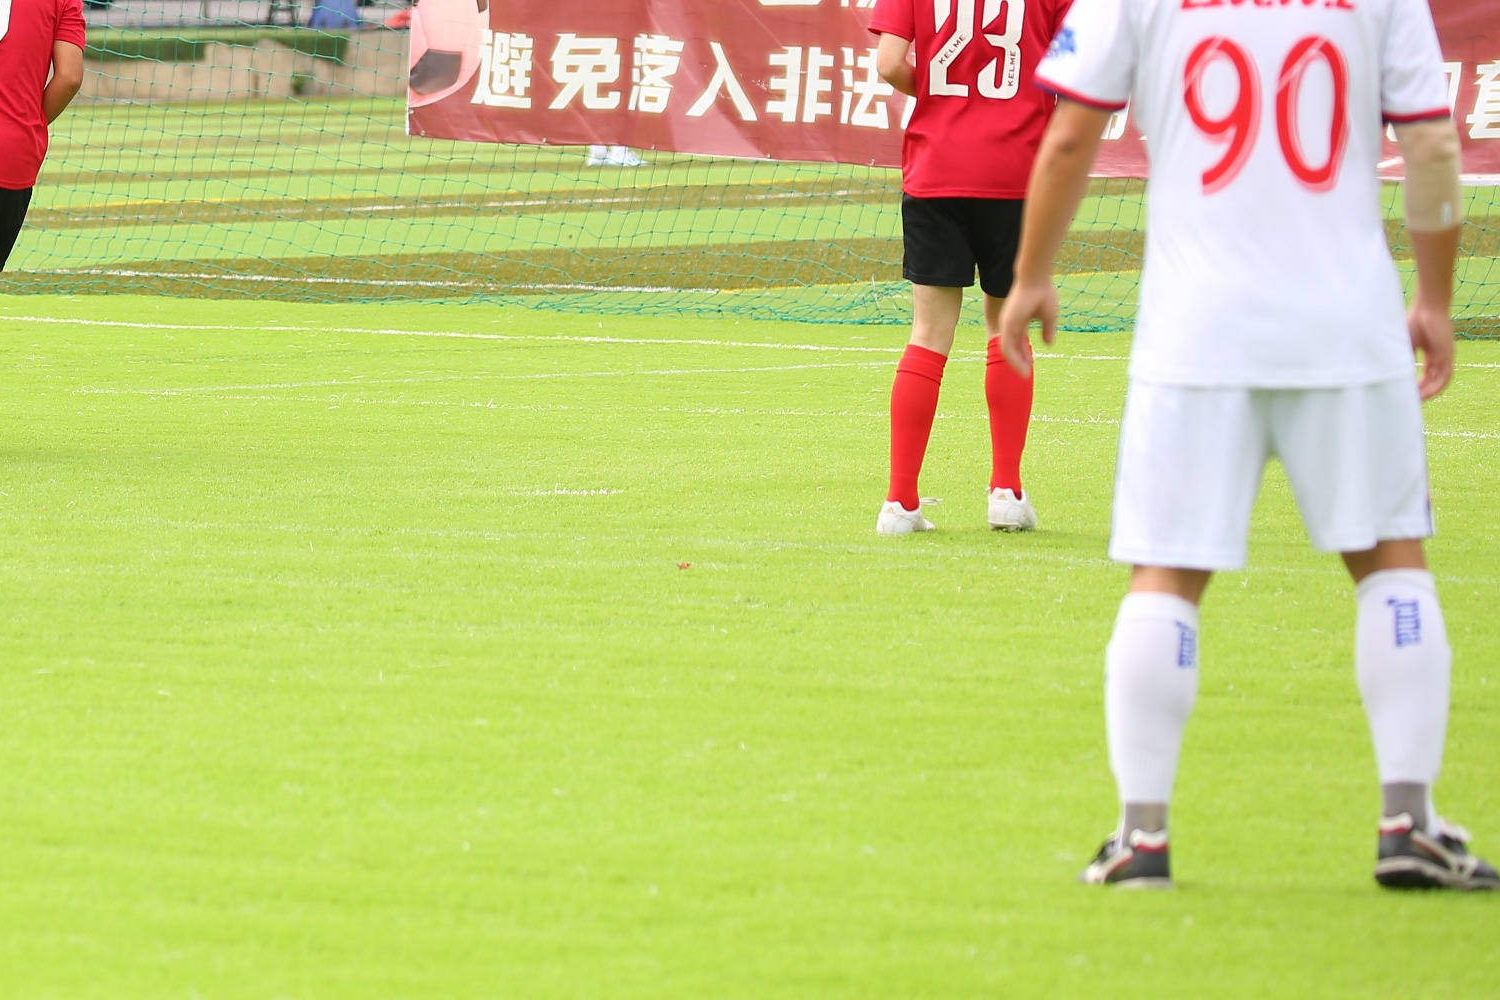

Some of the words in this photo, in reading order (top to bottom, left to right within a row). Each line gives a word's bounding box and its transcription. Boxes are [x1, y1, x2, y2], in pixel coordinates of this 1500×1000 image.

[470, 29, 894, 129] 避免落入非法
[938, 33, 967, 66] KELME
[1007, 49, 1017, 87] KELME
[1184, 34, 1350, 193] 90
